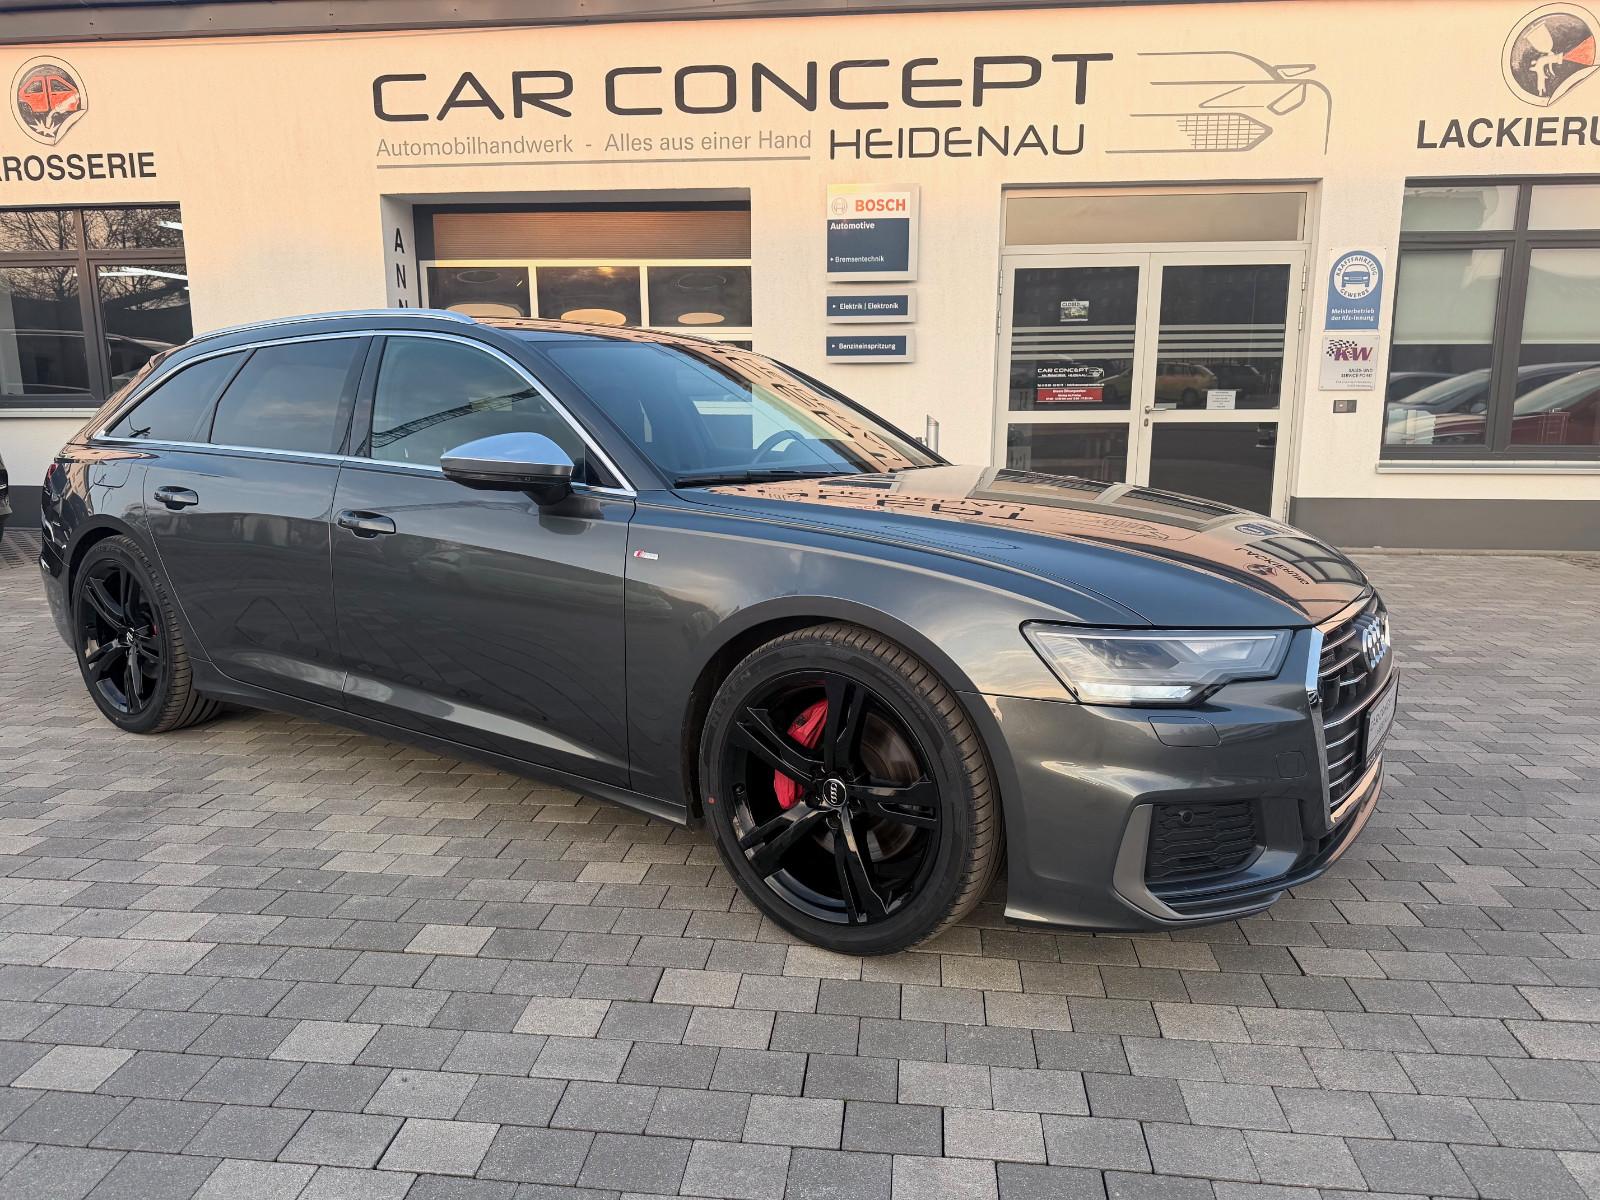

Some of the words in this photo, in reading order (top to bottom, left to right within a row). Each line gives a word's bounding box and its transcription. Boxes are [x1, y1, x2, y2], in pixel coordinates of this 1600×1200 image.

[372, 70, 574, 122] CAR
[604, 52, 1114, 115] CONCEPT
[376, 133, 574, 157] Automobilhandwerk
[604, 132, 653, 152] Alles
[659, 135, 694, 151] aus
[701, 131, 752, 151] einer
[758, 129, 812, 150] Hand
[829, 123, 1085, 160] HEIDENAU
[0, 151, 157, 181] ROSSERIE
[855, 198, 906, 212] BOSCH
[830, 221, 875, 230] Automotive
[834, 255, 885, 263] Bremsentechnik
[839, 302, 863, 310] Elektrik
[867, 302, 899, 310] Elektronik
[838, 342, 896, 351] Benzineinspritzung
[1334, 346, 1373, 361] KW
